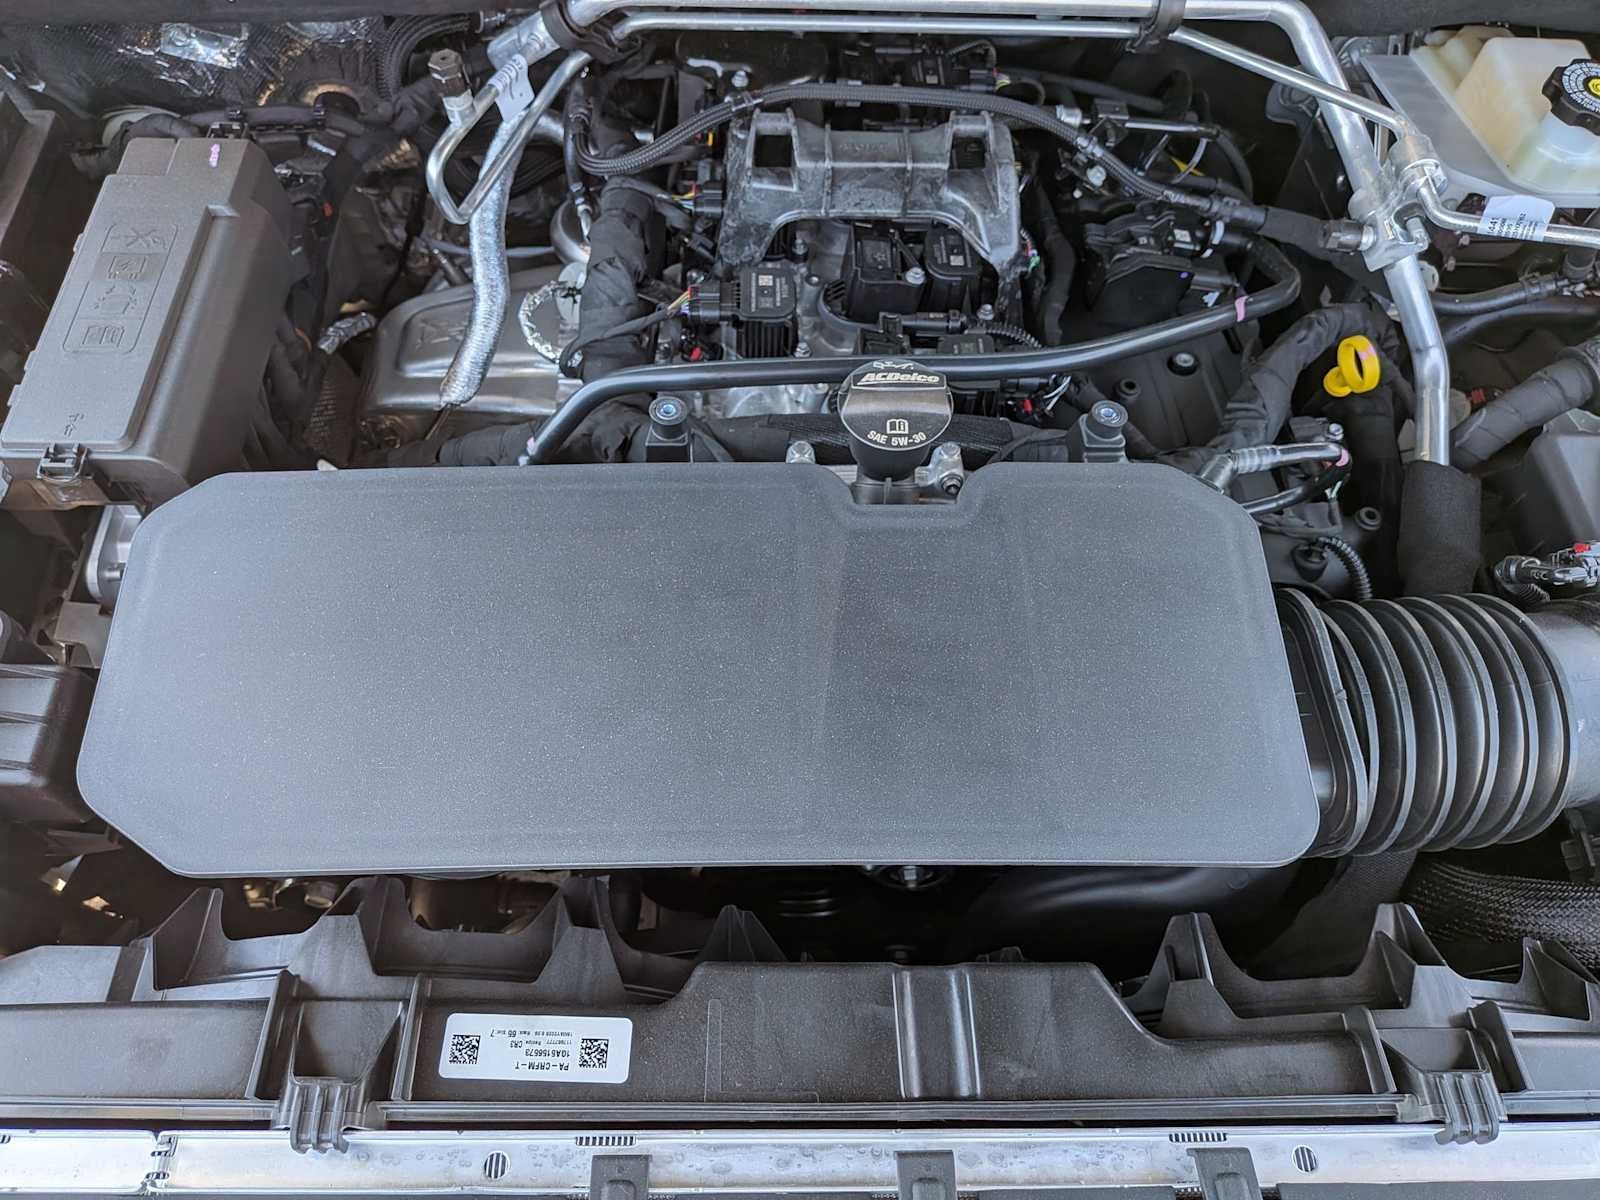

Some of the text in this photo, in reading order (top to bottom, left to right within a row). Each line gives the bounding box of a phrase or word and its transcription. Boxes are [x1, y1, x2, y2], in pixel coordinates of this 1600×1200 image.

[858, 372, 940, 384] ACDelco
[867, 431, 927, 446] SAE 5W-30
